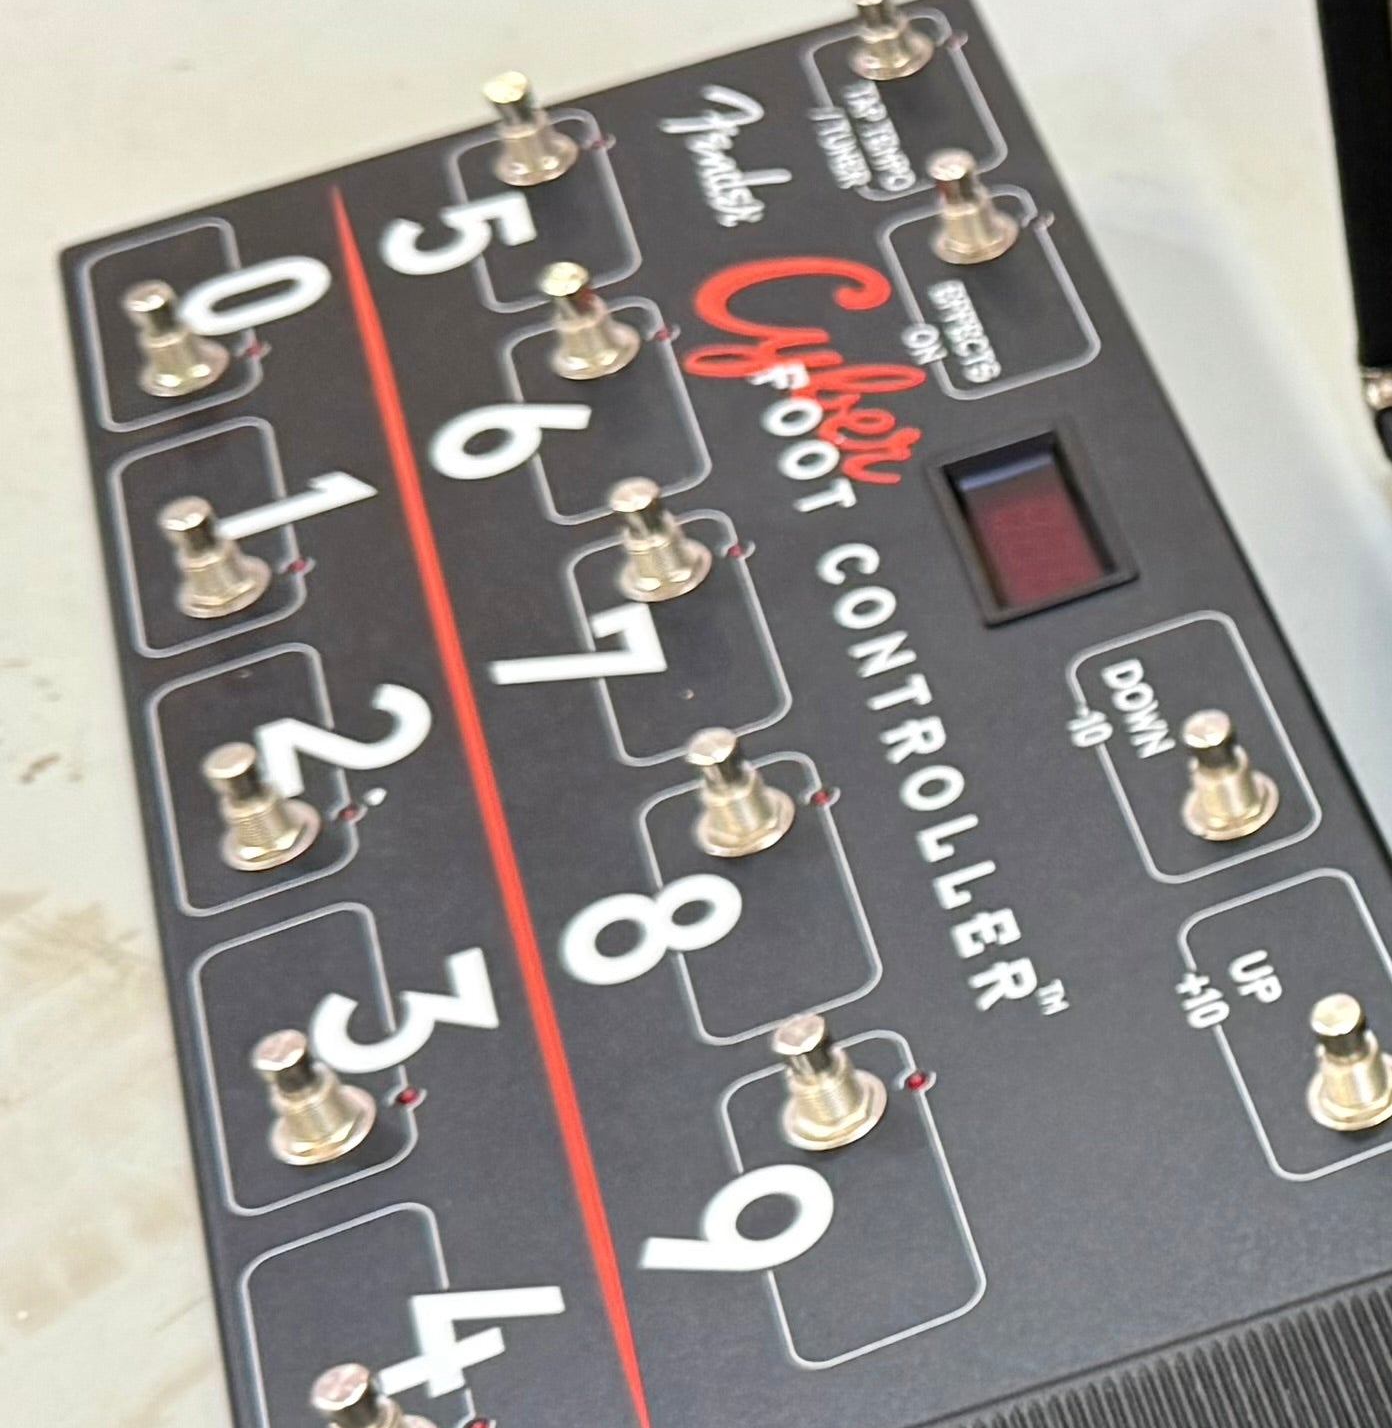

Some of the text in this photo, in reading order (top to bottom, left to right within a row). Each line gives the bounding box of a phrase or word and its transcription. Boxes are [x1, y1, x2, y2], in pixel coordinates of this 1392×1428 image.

[840, 79, 888, 123] TAP
[658, 84, 792, 227] Fender
[378, 192, 537, 275] 5
[177, 255, 332, 337] 0
[901, 322, 948, 366] ON
[927, 278, 1002, 384] EFFECTS
[683, 255, 927, 484] Cyber
[429, 402, 592, 481] 6
[214, 470, 380, 540] 1
[488, 601, 668, 685] 7
[747, 359, 1071, 1016] FOOT CONTROLLER TM
[254, 682, 433, 798] 2
[1100, 658, 1176, 760] DOWN
[560, 872, 743, 985] 8
[1228, 949, 1284, 1004] UP
[310, 947, 500, 1074] 3
[1174, 967, 1231, 1029] +10
[638, 1163, 835, 1272] 9
[370, 1285, 565, 1398] 4
